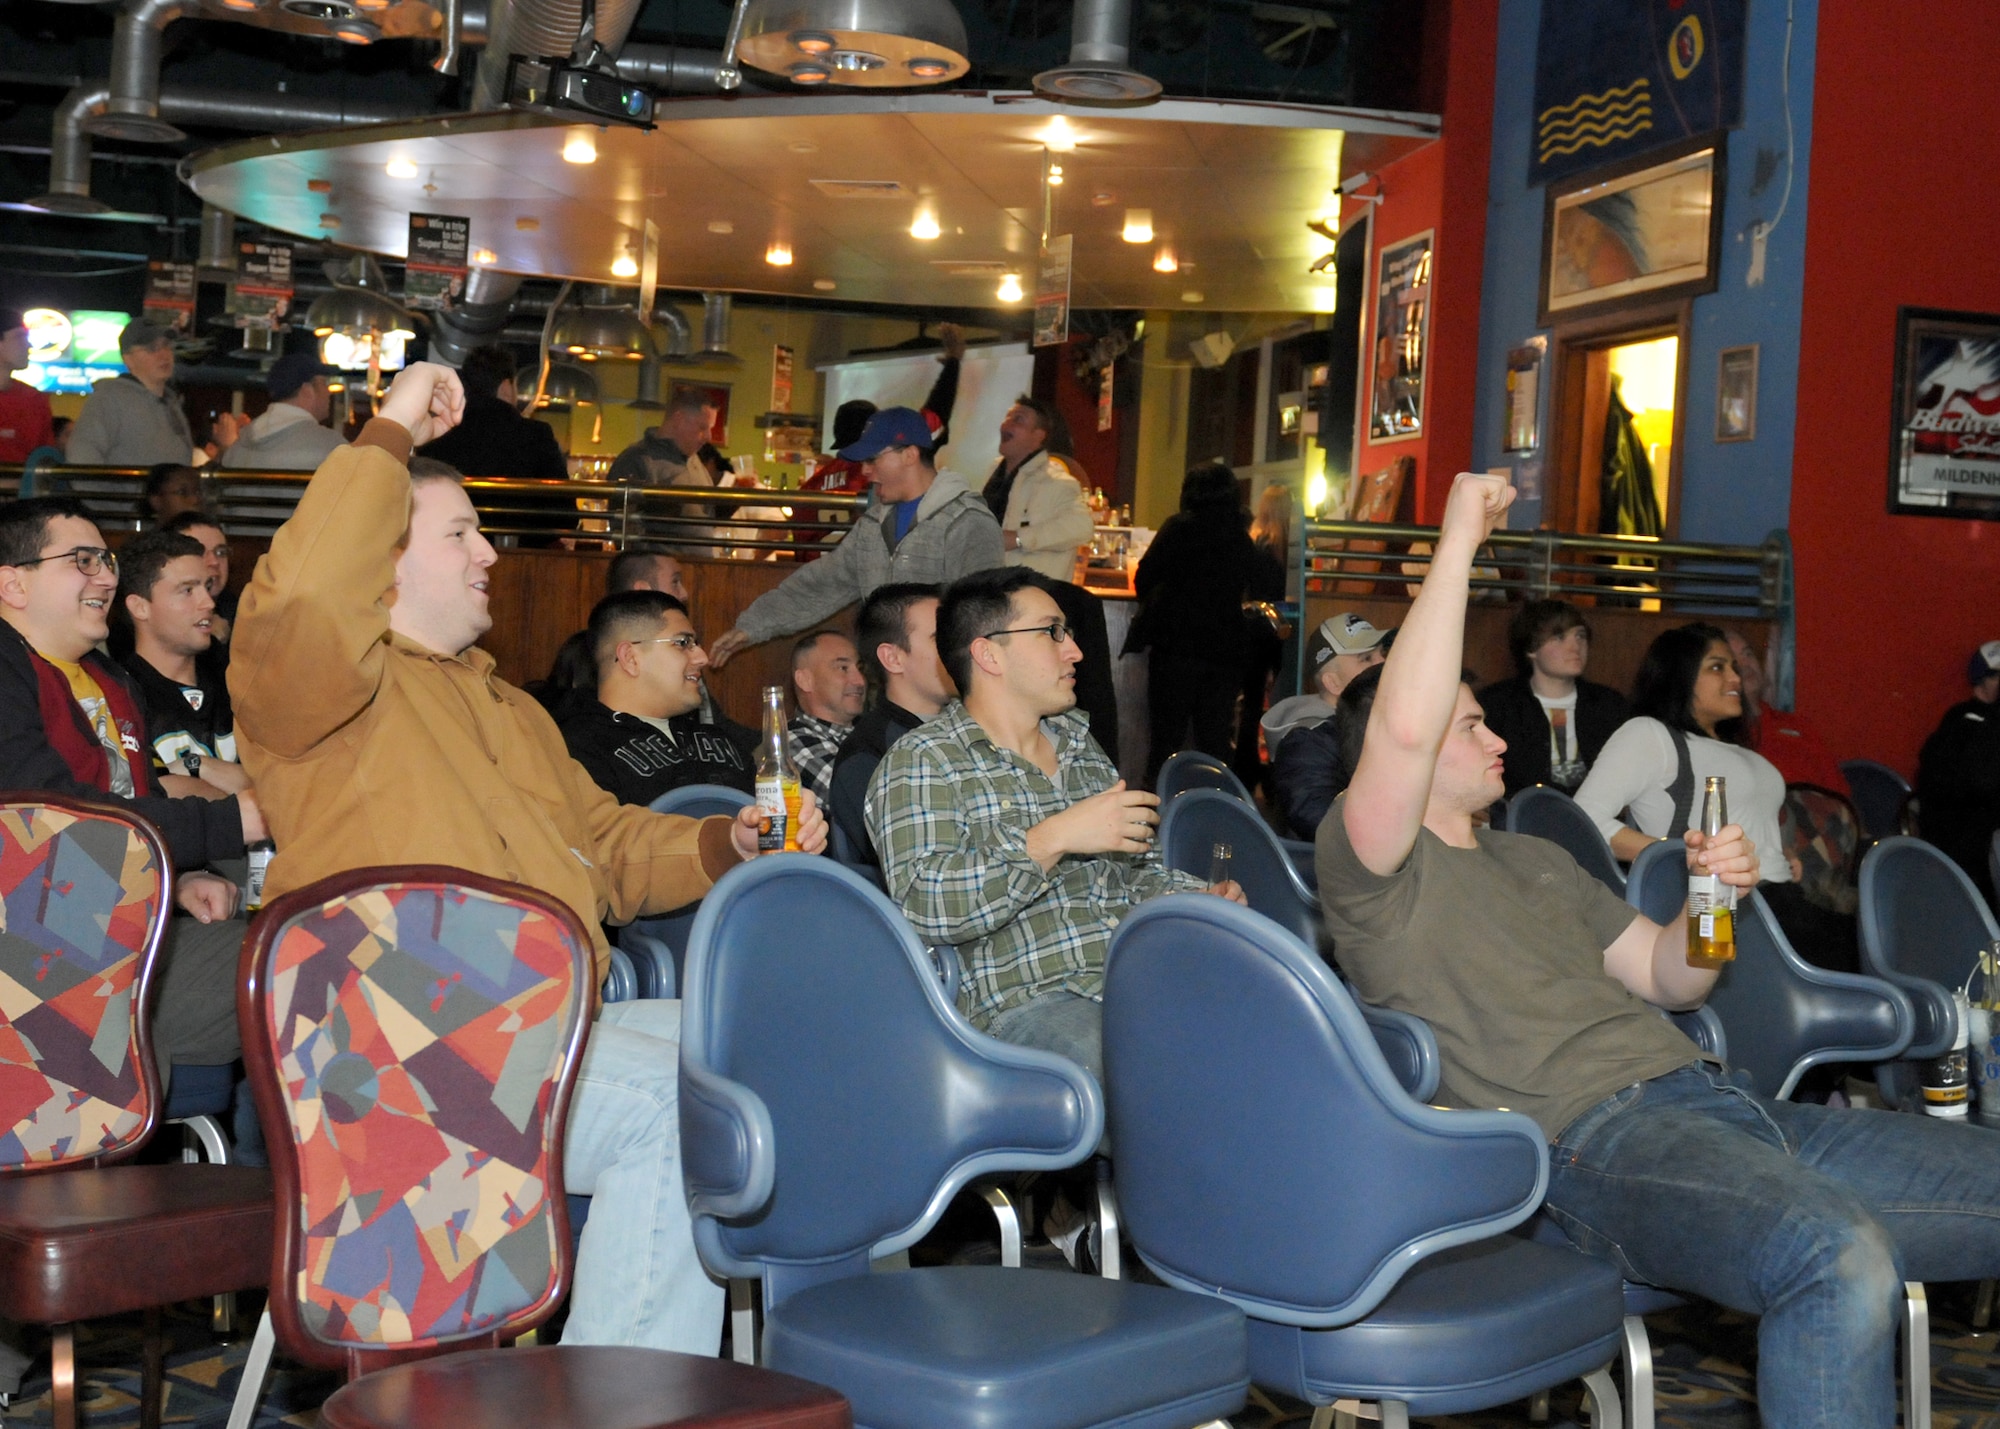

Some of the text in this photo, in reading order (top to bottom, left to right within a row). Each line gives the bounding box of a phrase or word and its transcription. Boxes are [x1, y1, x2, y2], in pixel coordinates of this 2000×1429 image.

[429, 219, 444, 229] Win
[452, 221, 466, 232] trip
[442, 231, 466, 240] to the
[418, 237, 441, 249] Super
